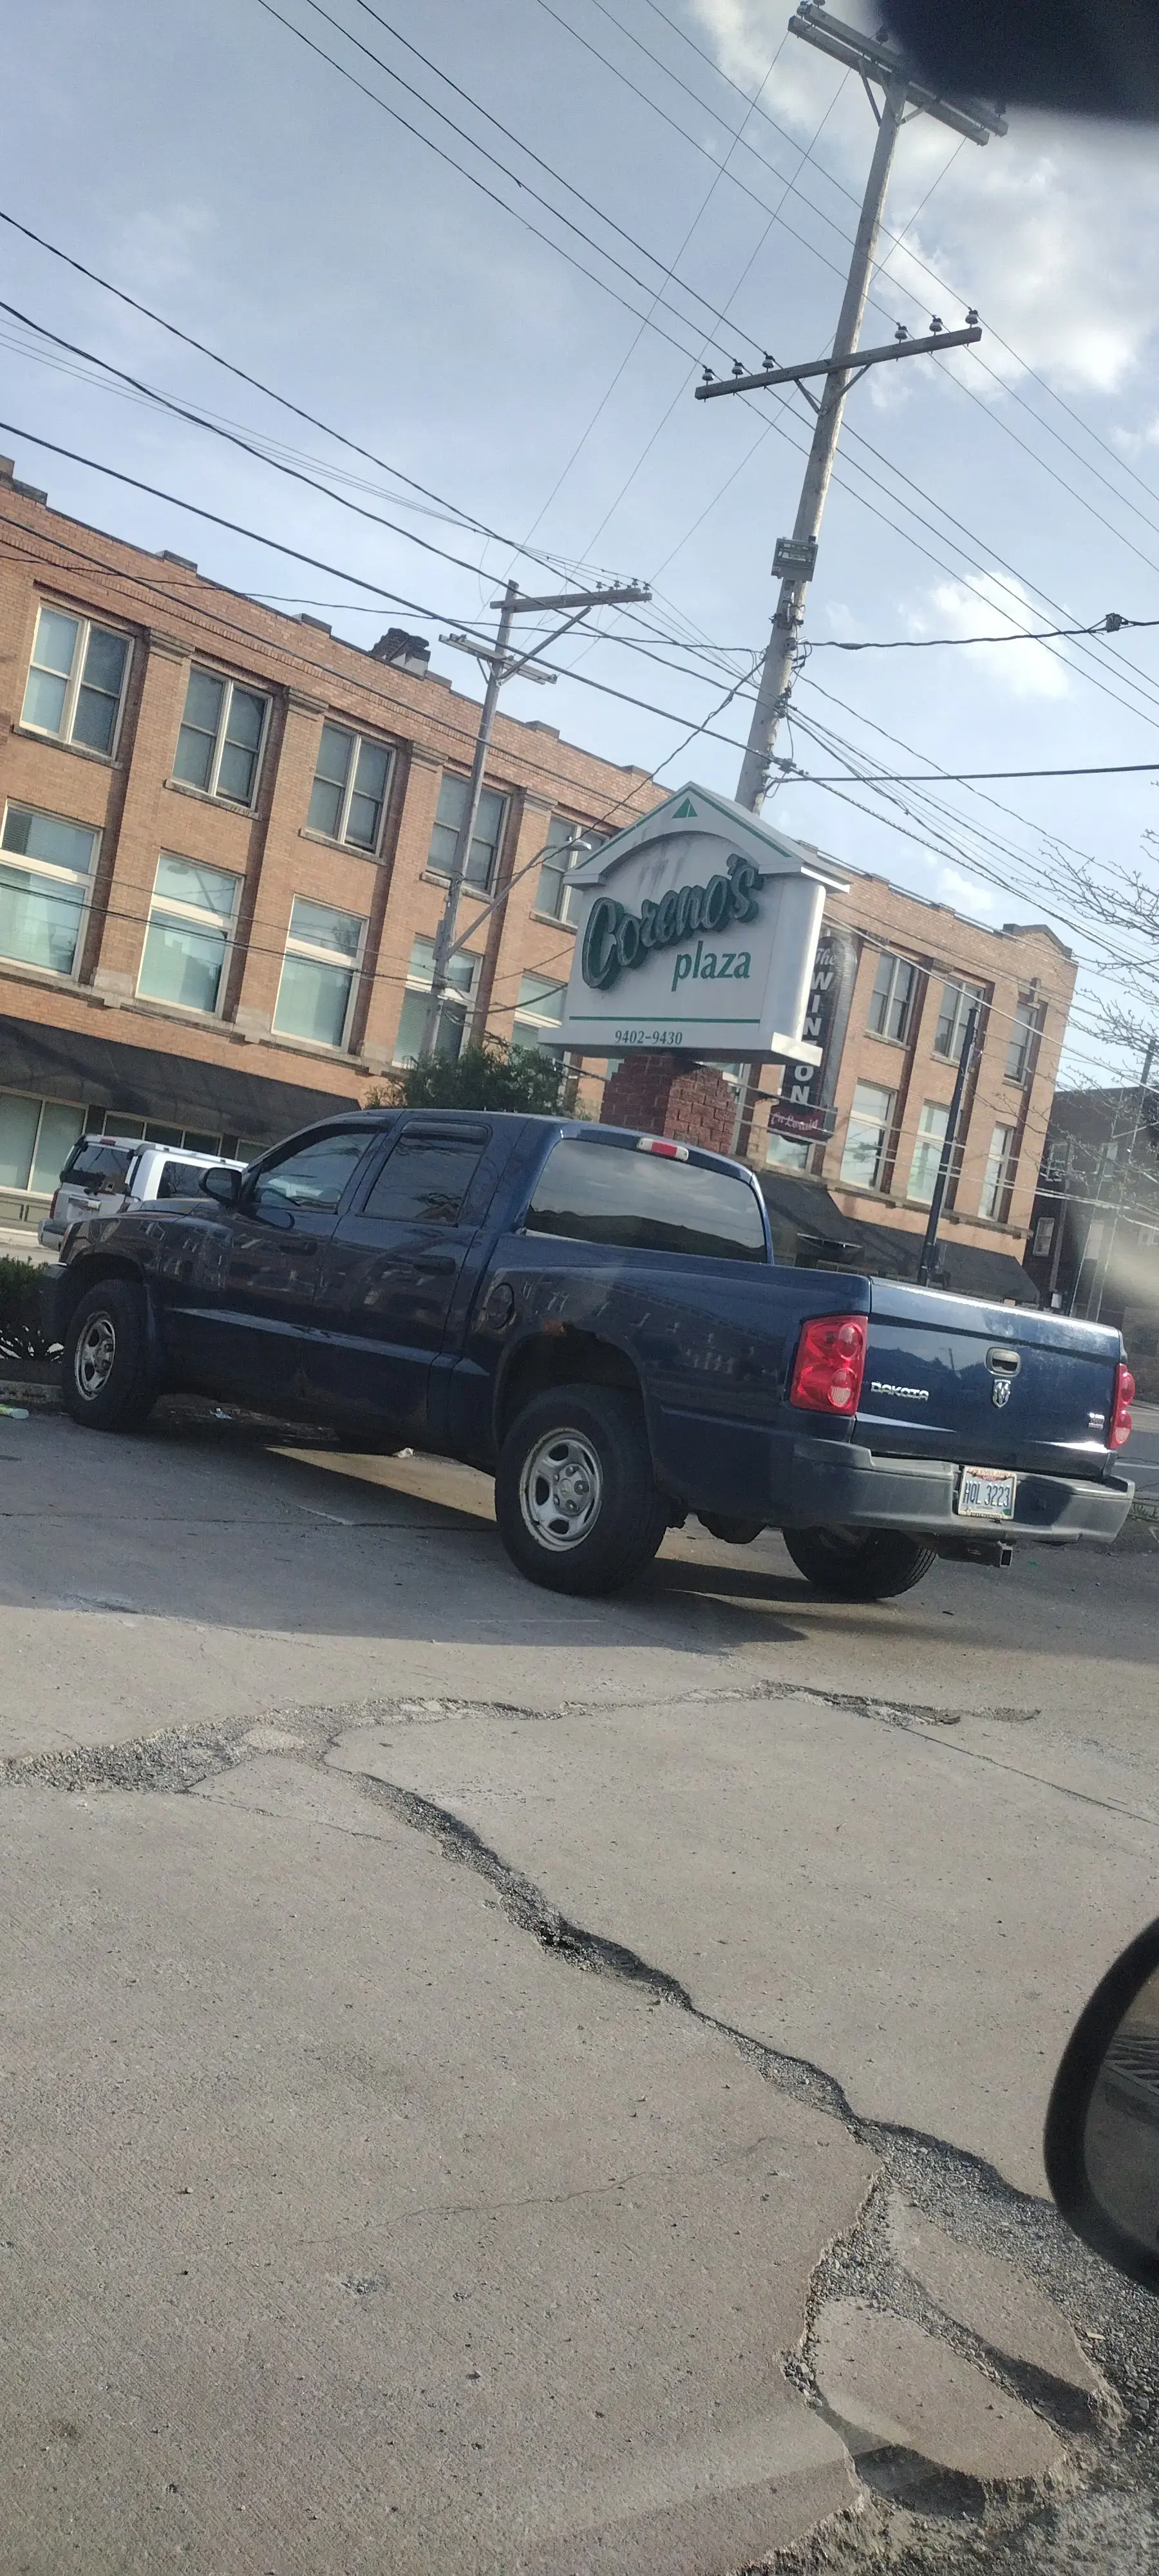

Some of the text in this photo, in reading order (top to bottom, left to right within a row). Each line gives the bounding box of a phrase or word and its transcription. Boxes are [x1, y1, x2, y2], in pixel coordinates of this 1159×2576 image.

[582, 853, 764, 990] Coreno's
[671, 940, 751, 992] plaza
[815, 948, 838, 965] The
[614, 1030, 683, 1045] 9402-9430
[789, 971, 834, 1105] WINON
[871, 1381, 929, 1402] DAKOTA
[985, 1482, 1010, 1508] 3223
